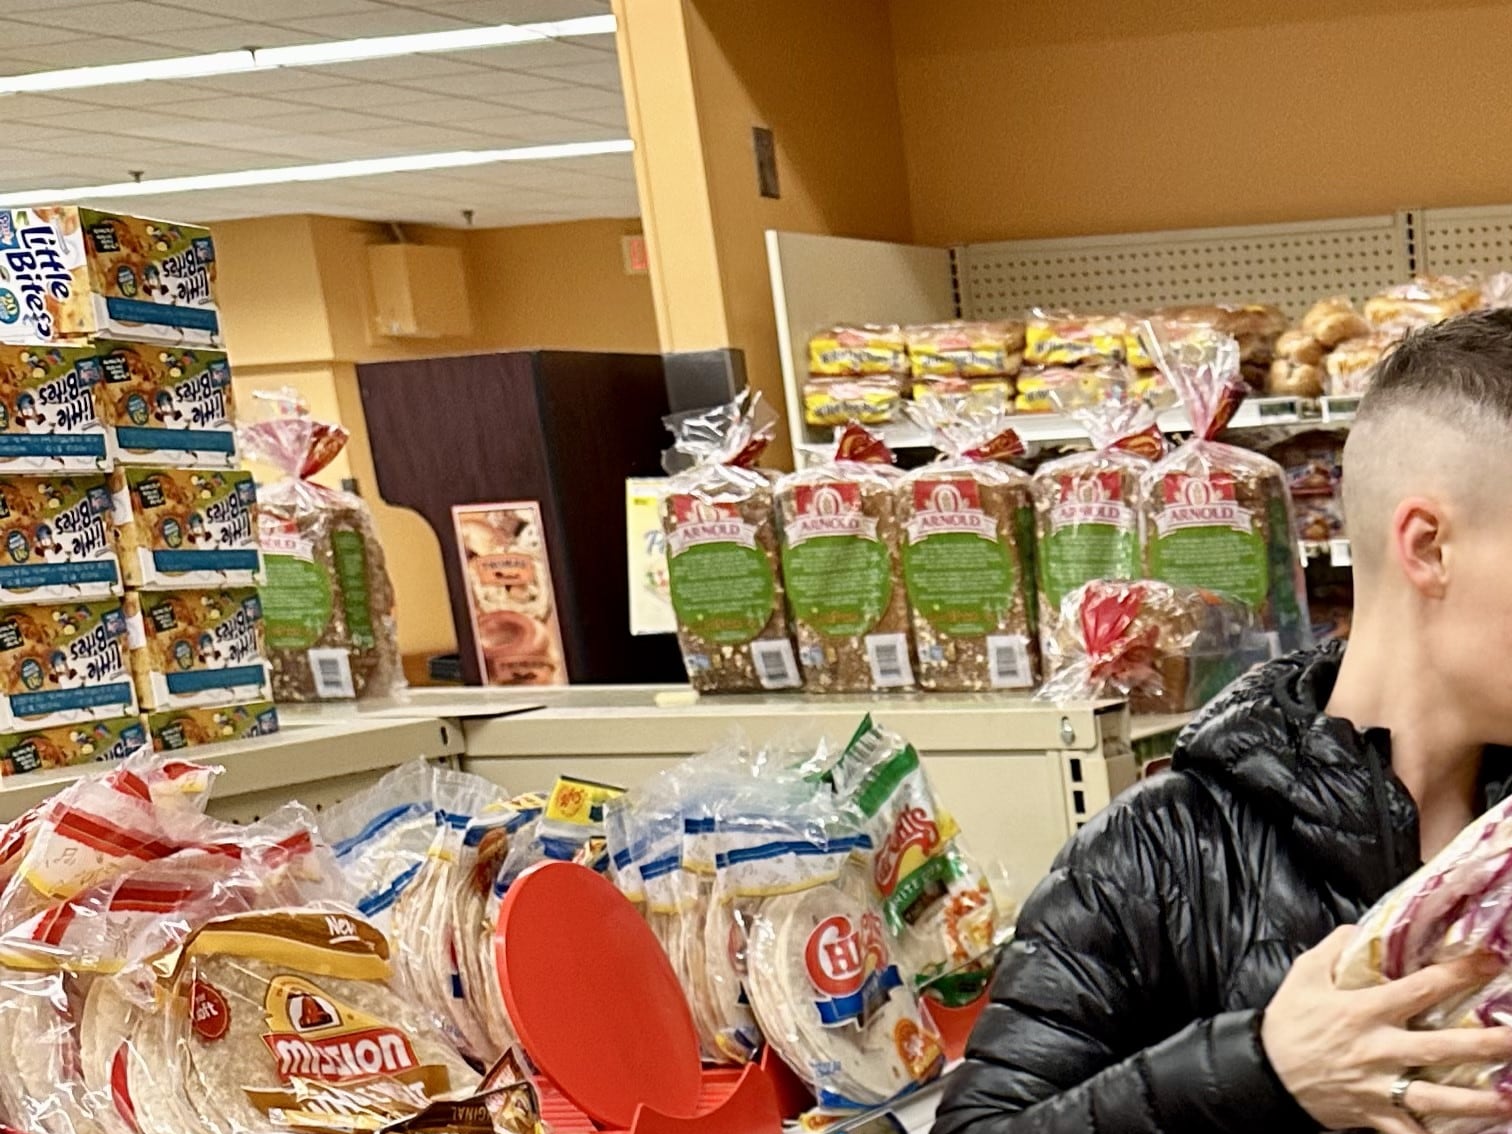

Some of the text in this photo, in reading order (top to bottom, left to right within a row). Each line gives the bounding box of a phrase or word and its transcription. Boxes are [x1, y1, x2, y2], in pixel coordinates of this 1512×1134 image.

[21, 226, 72, 300] Little
[163, 248, 196, 276] Bites
[7, 252, 52, 337] Bites
[176, 267, 209, 303] Little
[39, 372, 78, 405] Bites
[176, 371, 211, 402] Bites
[57, 390, 94, 430] Little
[191, 390, 225, 426] Little
[55, 500, 92, 535] Bites
[206, 494, 237, 523] Bites
[921, 515, 980, 527] ARNOLD
[1172, 507, 1233, 519] ARNOLD
[71, 517, 107, 557] Little
[221, 507, 251, 547] Little
[683, 524, 739, 537] ARNOLD
[70, 626, 107, 659] Bites
[216, 613, 244, 643] Bites
[229, 627, 257, 663] Little
[87, 643, 122, 681] Little
